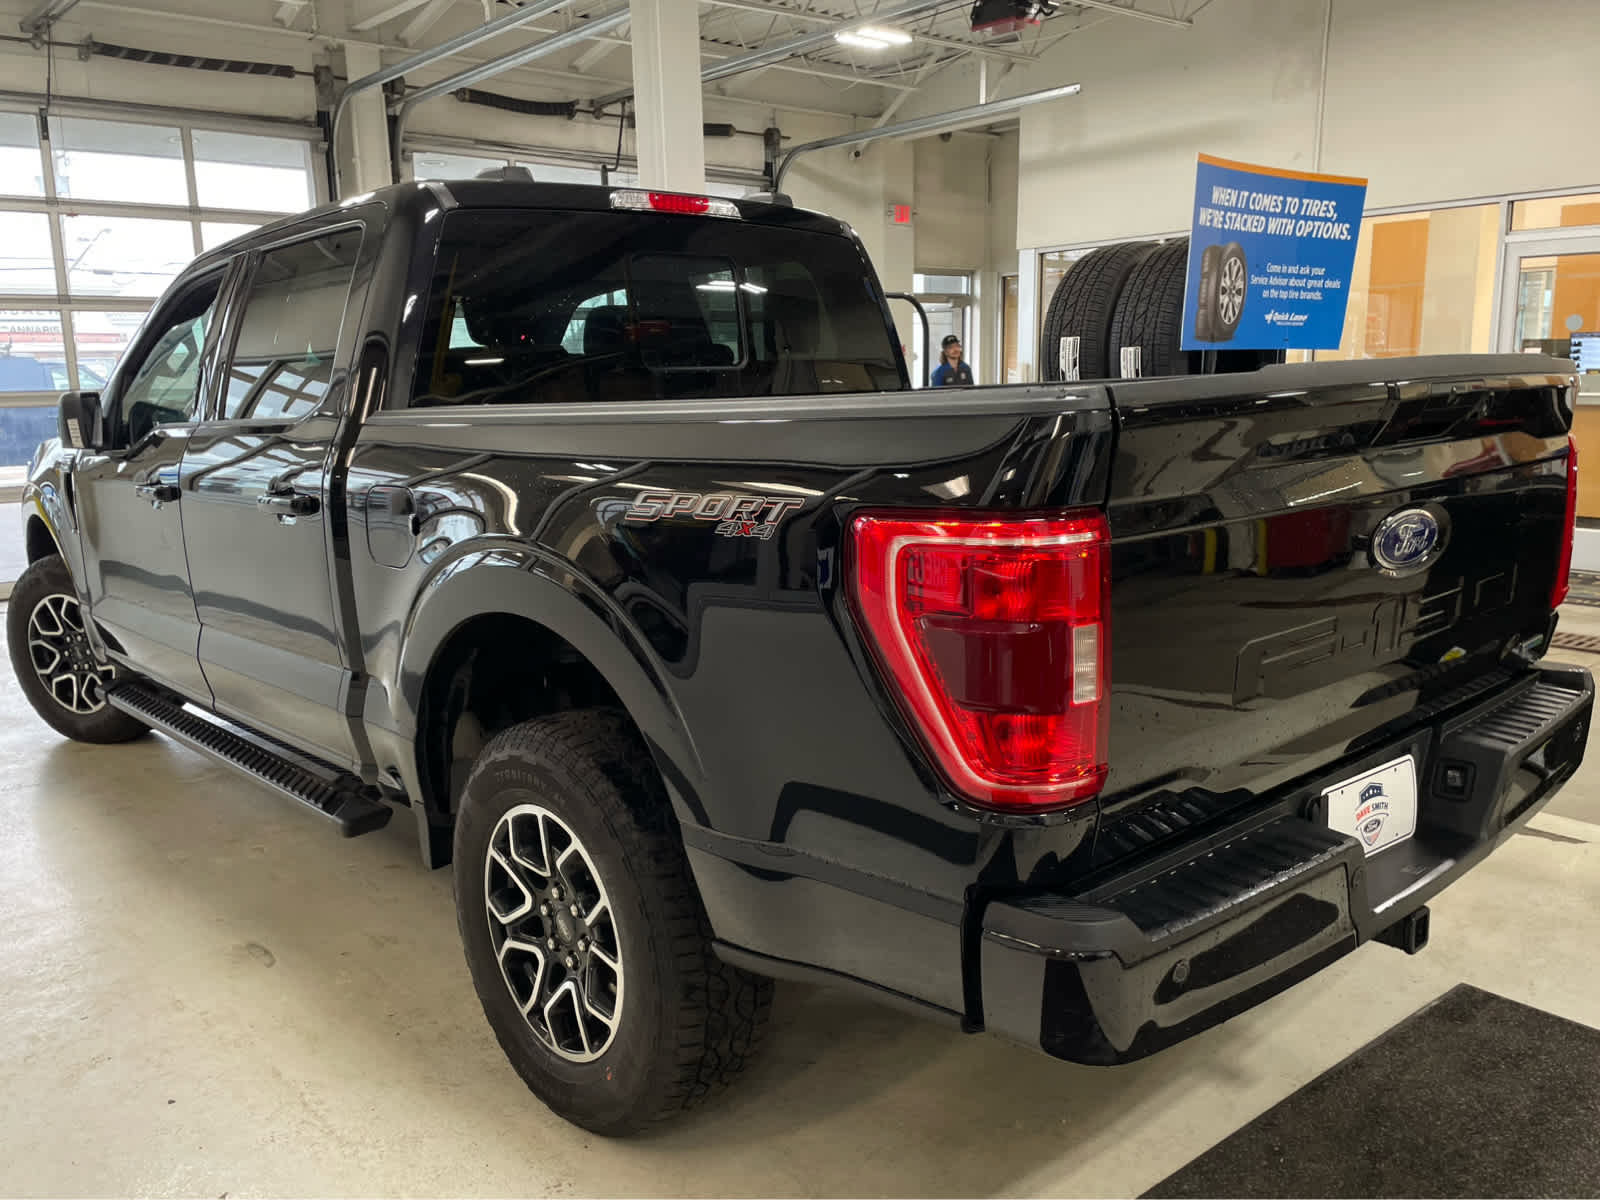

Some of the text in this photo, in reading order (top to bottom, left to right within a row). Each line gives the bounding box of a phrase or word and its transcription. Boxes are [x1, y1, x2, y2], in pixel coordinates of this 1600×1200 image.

[1212, 186, 1337, 221] WHEN IT COMES TO TIRES,
[1199, 207, 1351, 240] WE'RE STACKED WITH OPTIONS.
[1250, 274, 1341, 289] Service Advisor about great deals
[1267, 262, 1326, 276] Come in and ask your
[1262, 290, 1270, 298] on
[1270, 289, 1278, 298] the
[1280, 290, 1288, 300] top
[1288, 290, 1299, 299] tire
[624, 490, 805, 525] SPORT
[1394, 523, 1430, 557] Ford
